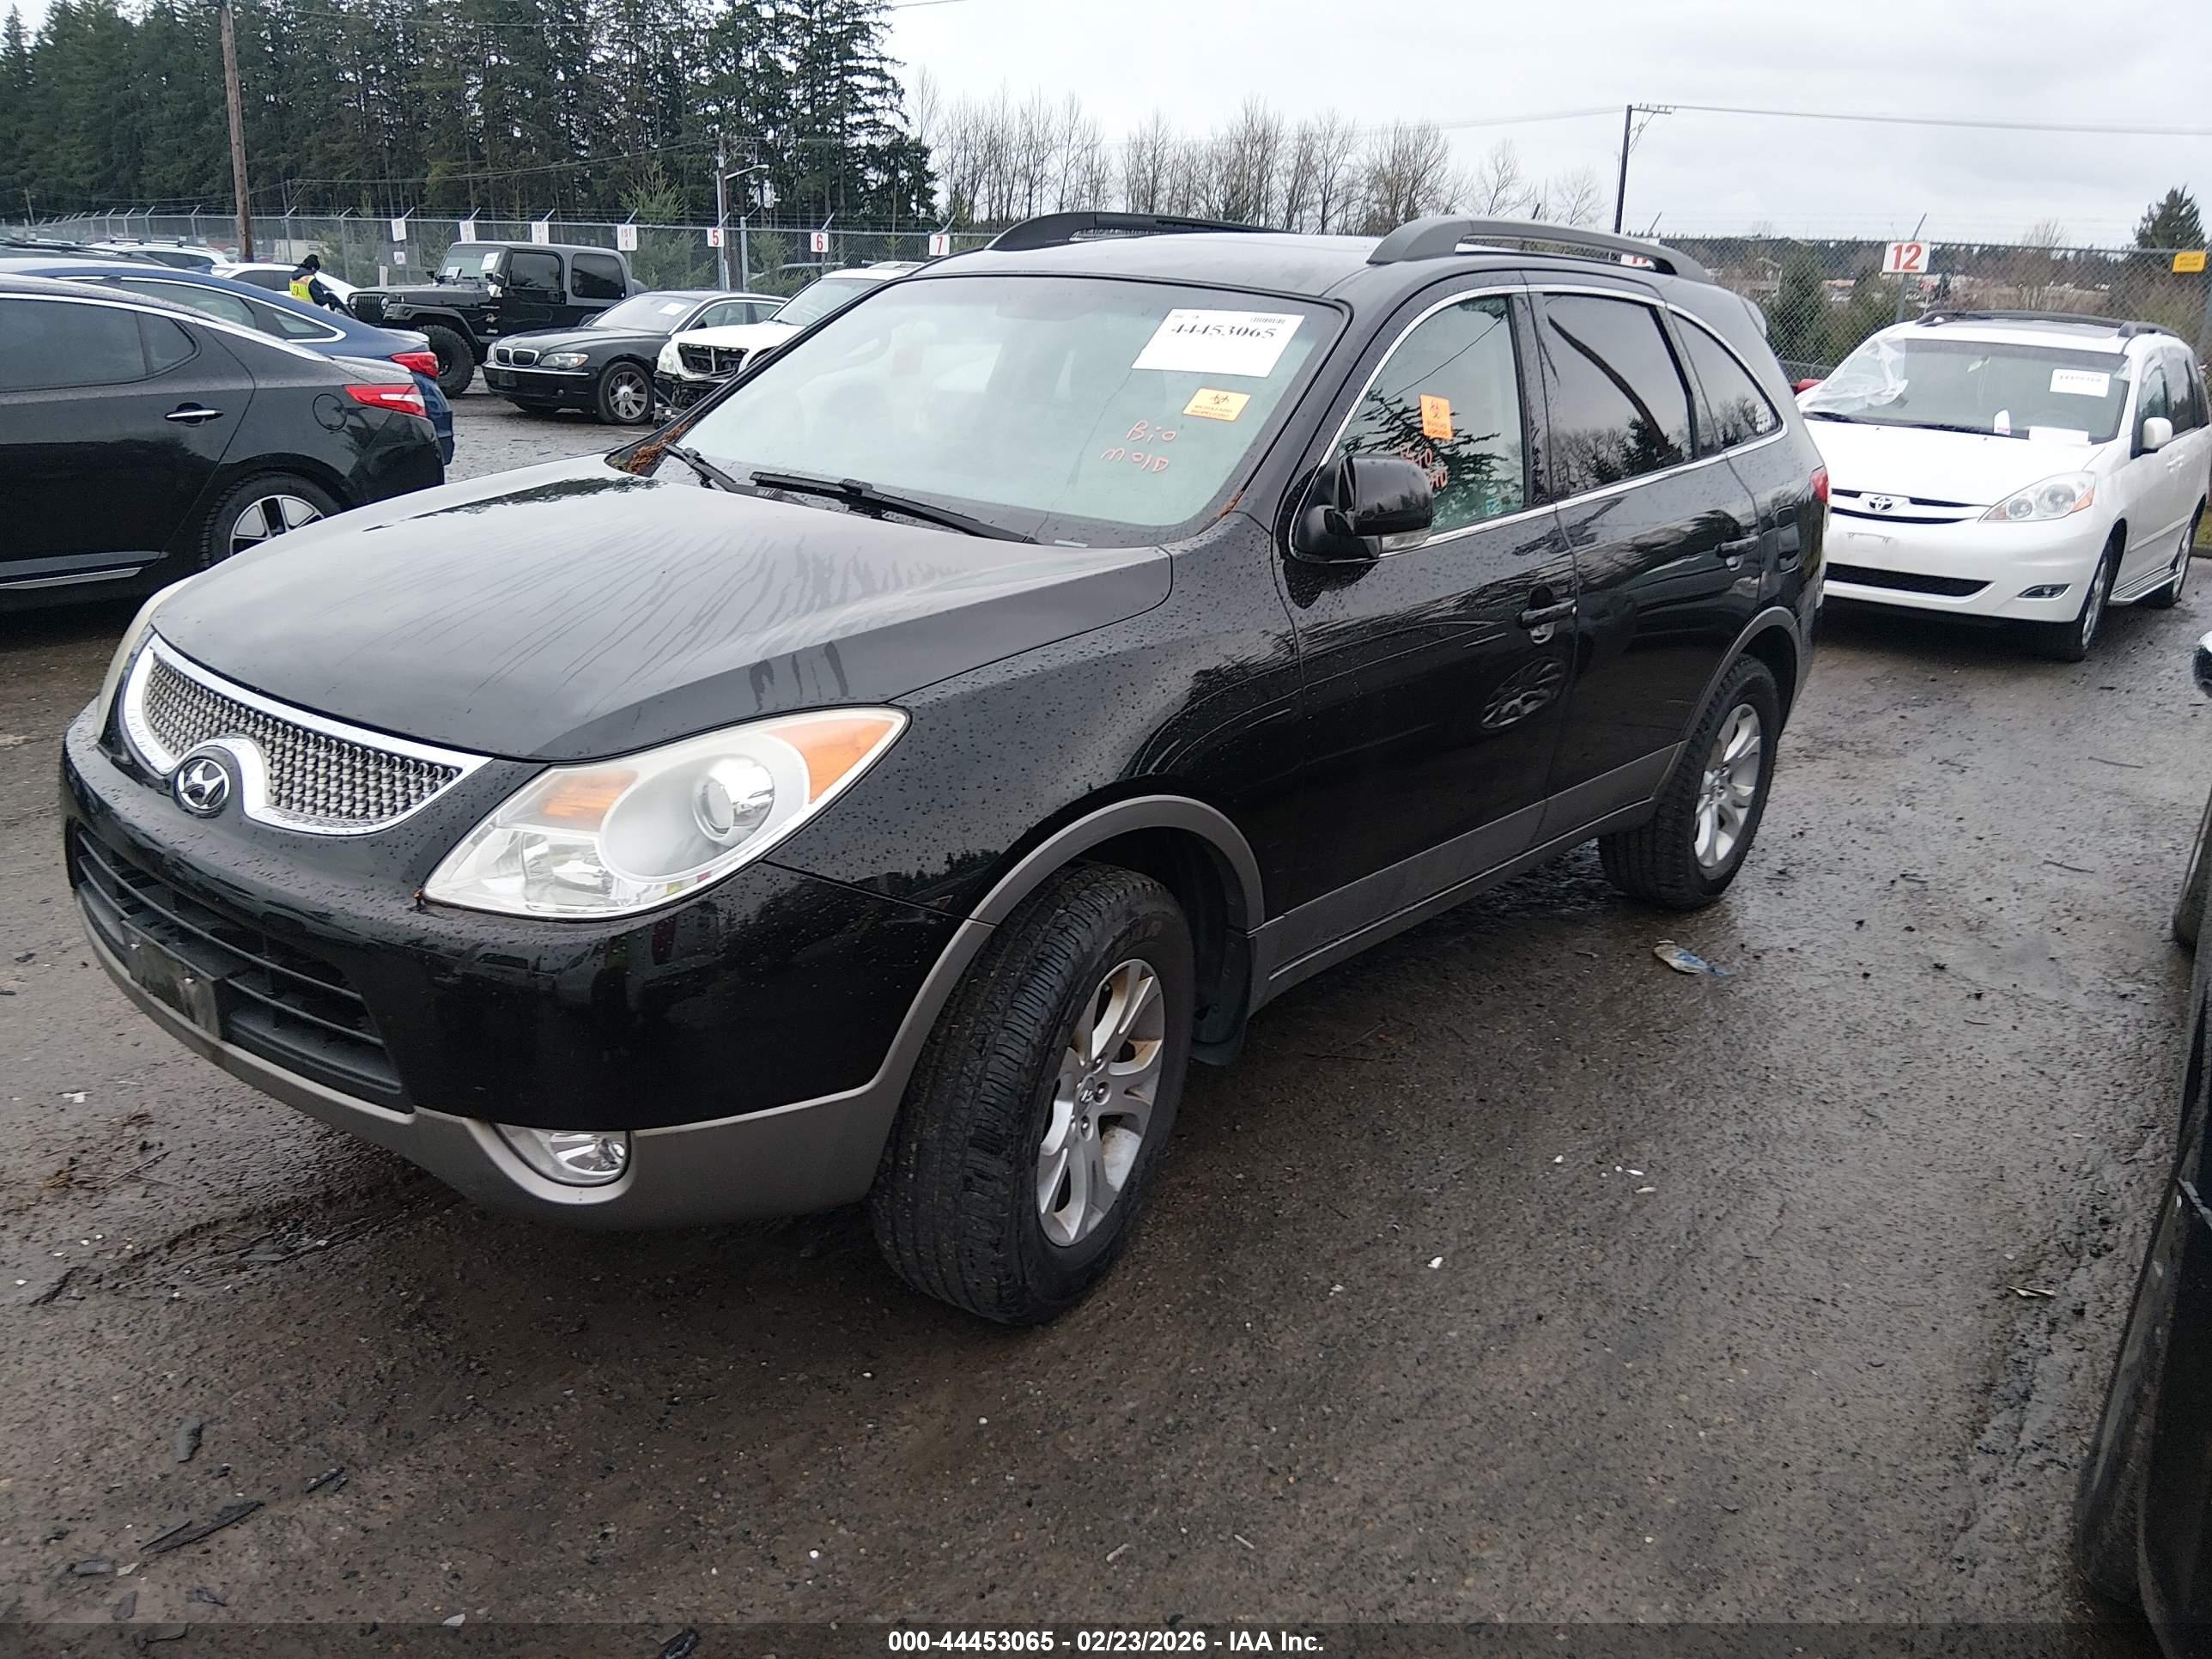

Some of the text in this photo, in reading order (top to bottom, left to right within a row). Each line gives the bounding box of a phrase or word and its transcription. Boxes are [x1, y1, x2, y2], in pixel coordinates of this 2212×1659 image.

[712, 228, 720, 246] 5
[816, 233, 823, 251] 6
[936, 235, 944, 255] 7
[1893, 243, 1922, 270] 12
[1170, 323, 1278, 338] 44453065
